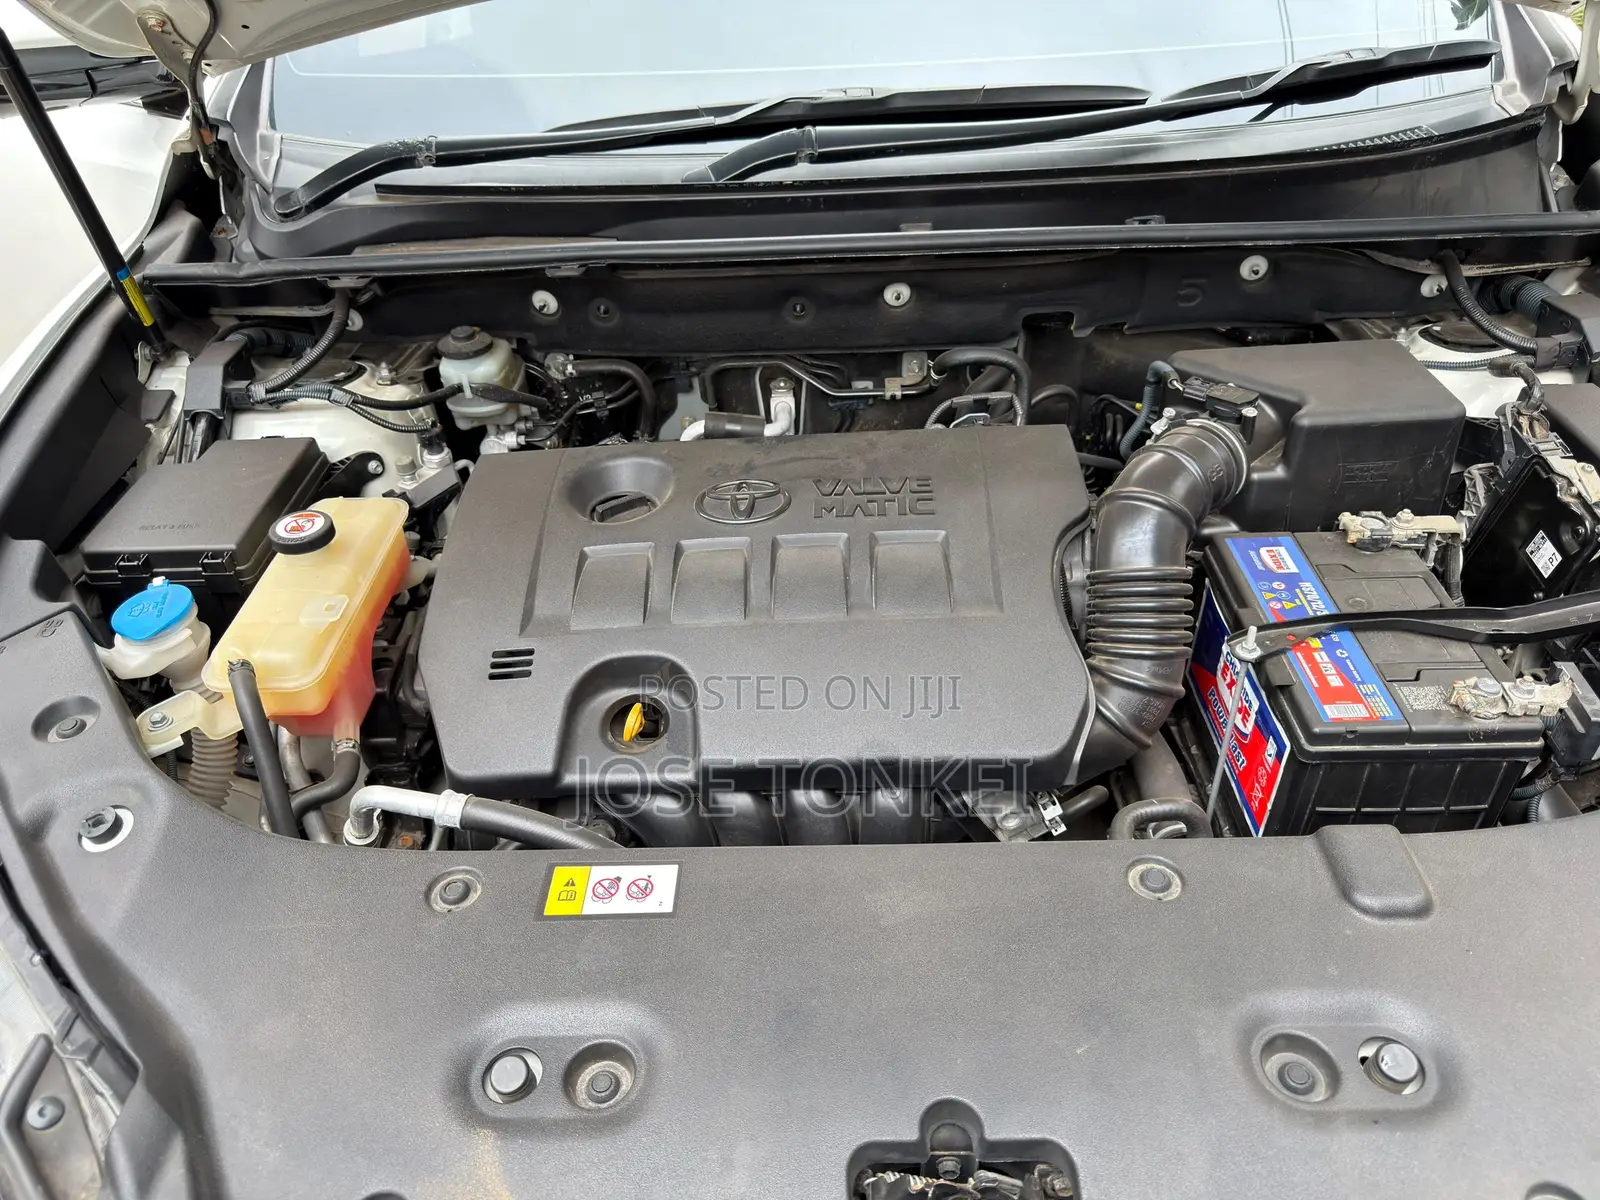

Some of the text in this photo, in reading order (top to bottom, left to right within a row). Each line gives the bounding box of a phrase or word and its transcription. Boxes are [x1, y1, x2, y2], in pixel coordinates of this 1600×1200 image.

[812, 477, 933, 496] VALVE
[813, 497, 935, 518] MATIC
[1266, 549, 1286, 571] EXIDE
[1221, 661, 1251, 728] EXDE
